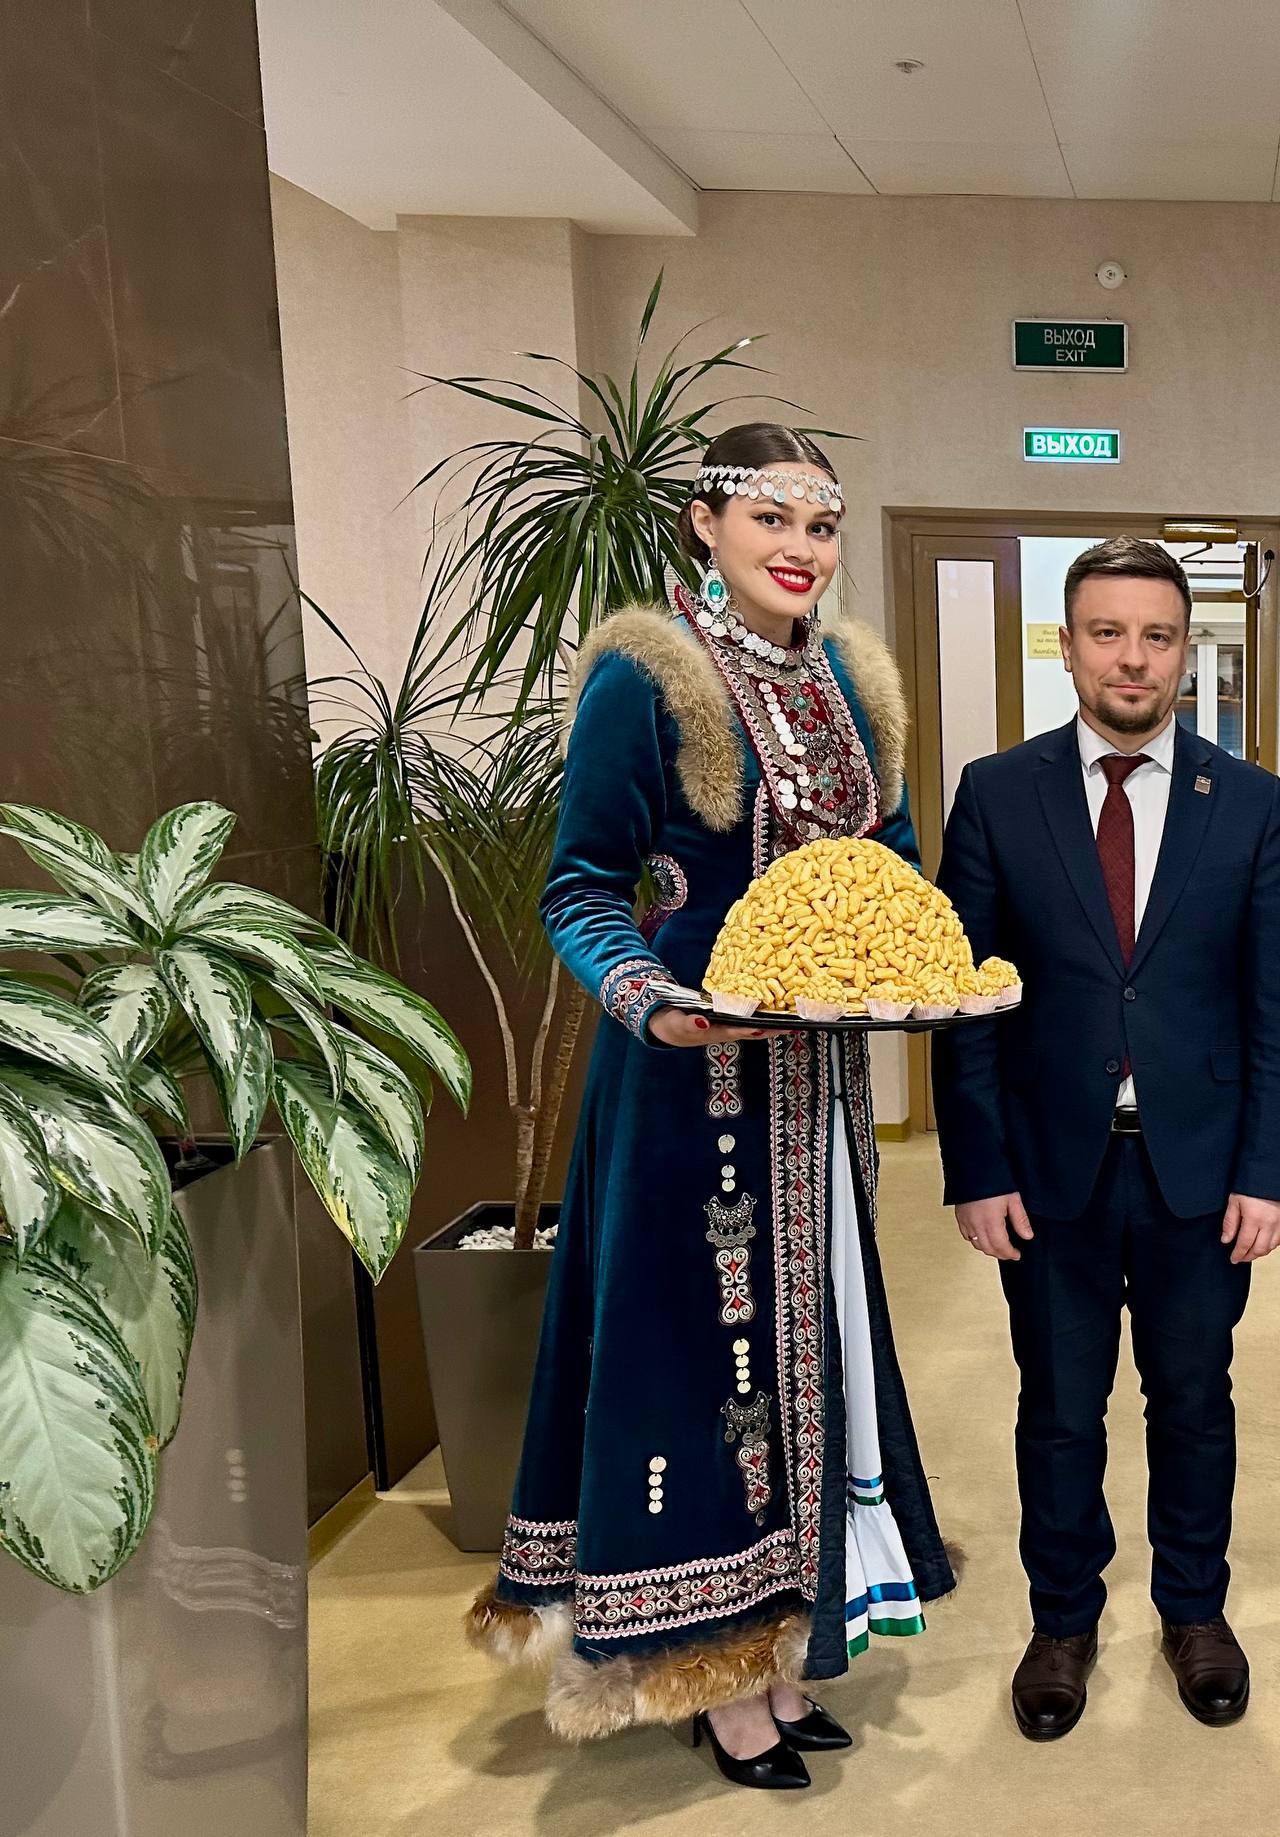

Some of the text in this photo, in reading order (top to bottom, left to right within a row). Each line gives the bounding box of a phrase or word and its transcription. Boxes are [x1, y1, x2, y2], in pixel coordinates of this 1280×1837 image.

[1044, 329, 1096, 348] ВЫХОД
[1056, 349, 1086, 362] EXIT
[1033, 434, 1111, 457] ВЫХОД
